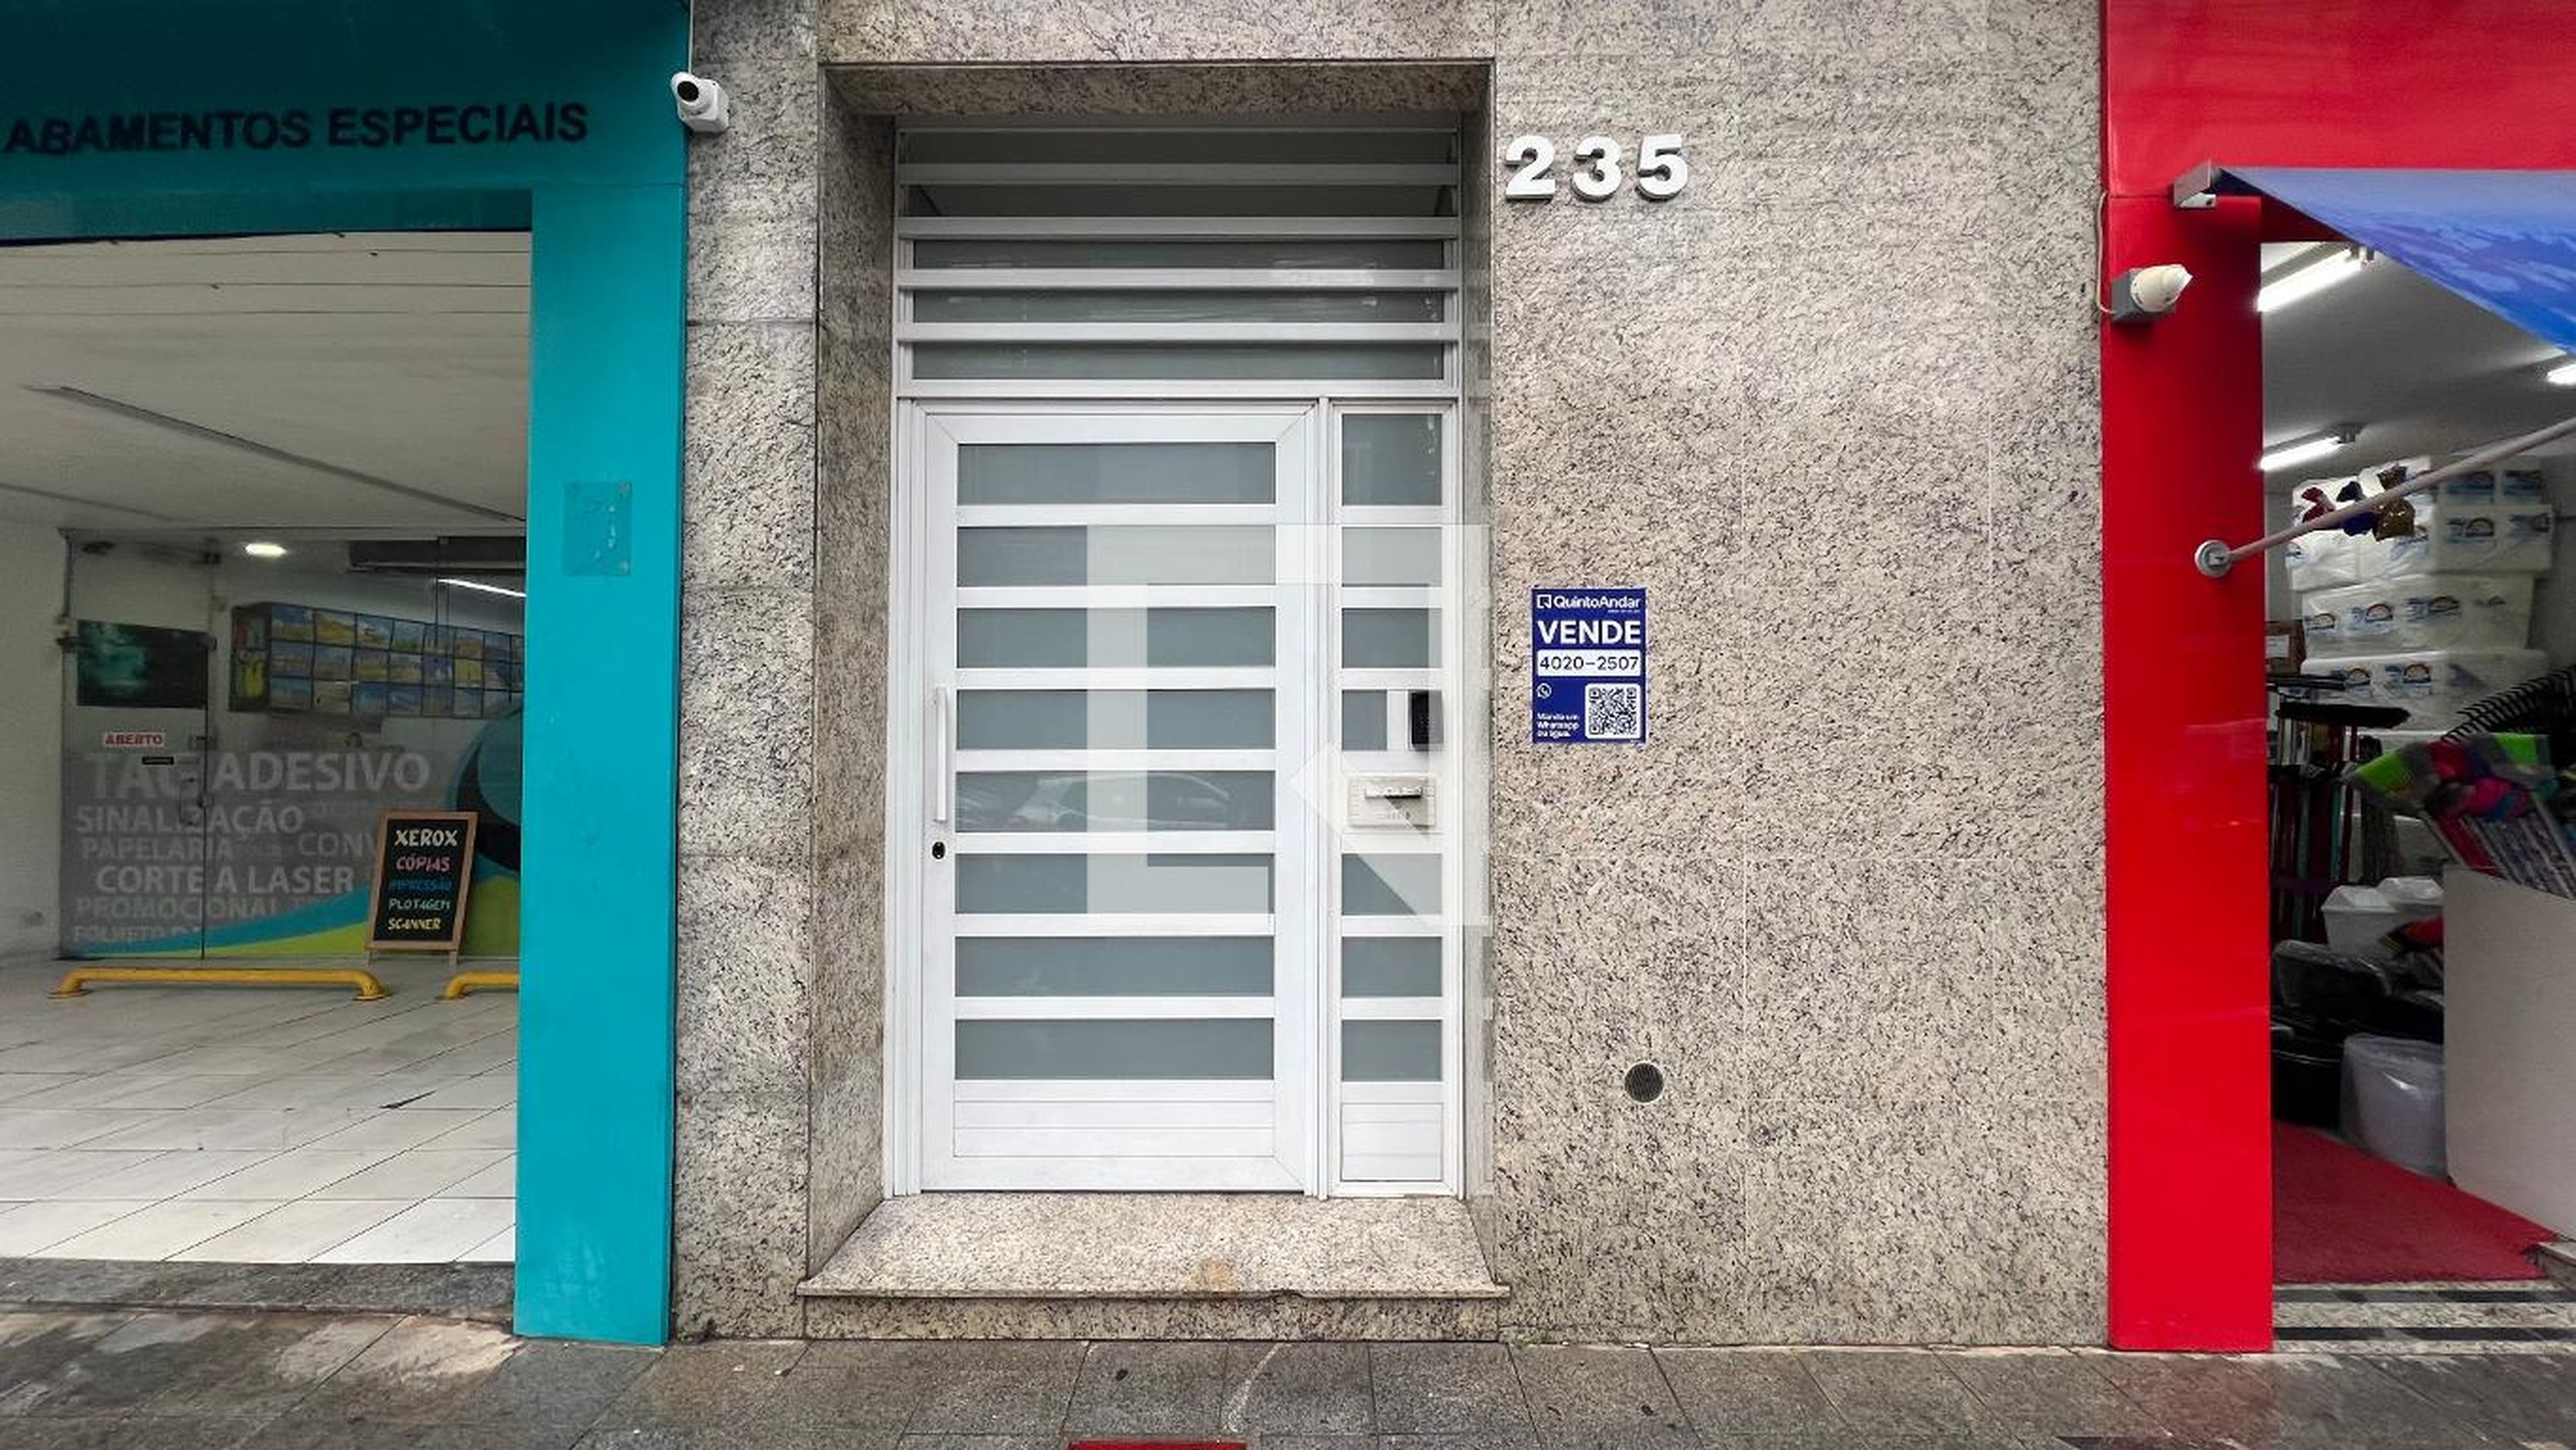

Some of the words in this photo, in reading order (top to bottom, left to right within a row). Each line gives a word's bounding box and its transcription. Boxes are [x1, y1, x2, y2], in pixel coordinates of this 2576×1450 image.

[3, 110, 313, 155] ABAMENTOS
[328, 103, 589, 147] ESPECIAIS
[1505, 134, 1689, 199] 235
[1553, 596, 1642, 609] QuintoAndar
[1537, 619, 1642, 645] VENDE
[1539, 656, 1640, 671] 4020-2507
[105, 734, 163, 744] ABERTO
[212, 752, 431, 792] ADESIVO
[81, 837, 234, 861] PAPELARIA
[394, 829, 458, 847] XEROX
[95, 866, 203, 894] CORTE
[214, 866, 238, 894] A
[248, 866, 354, 894] LASER
[76, 898, 279, 920] PROMOCONAL
[388, 898, 451, 912] PLOTAGEM
[388, 917, 442, 931] SCANNER
